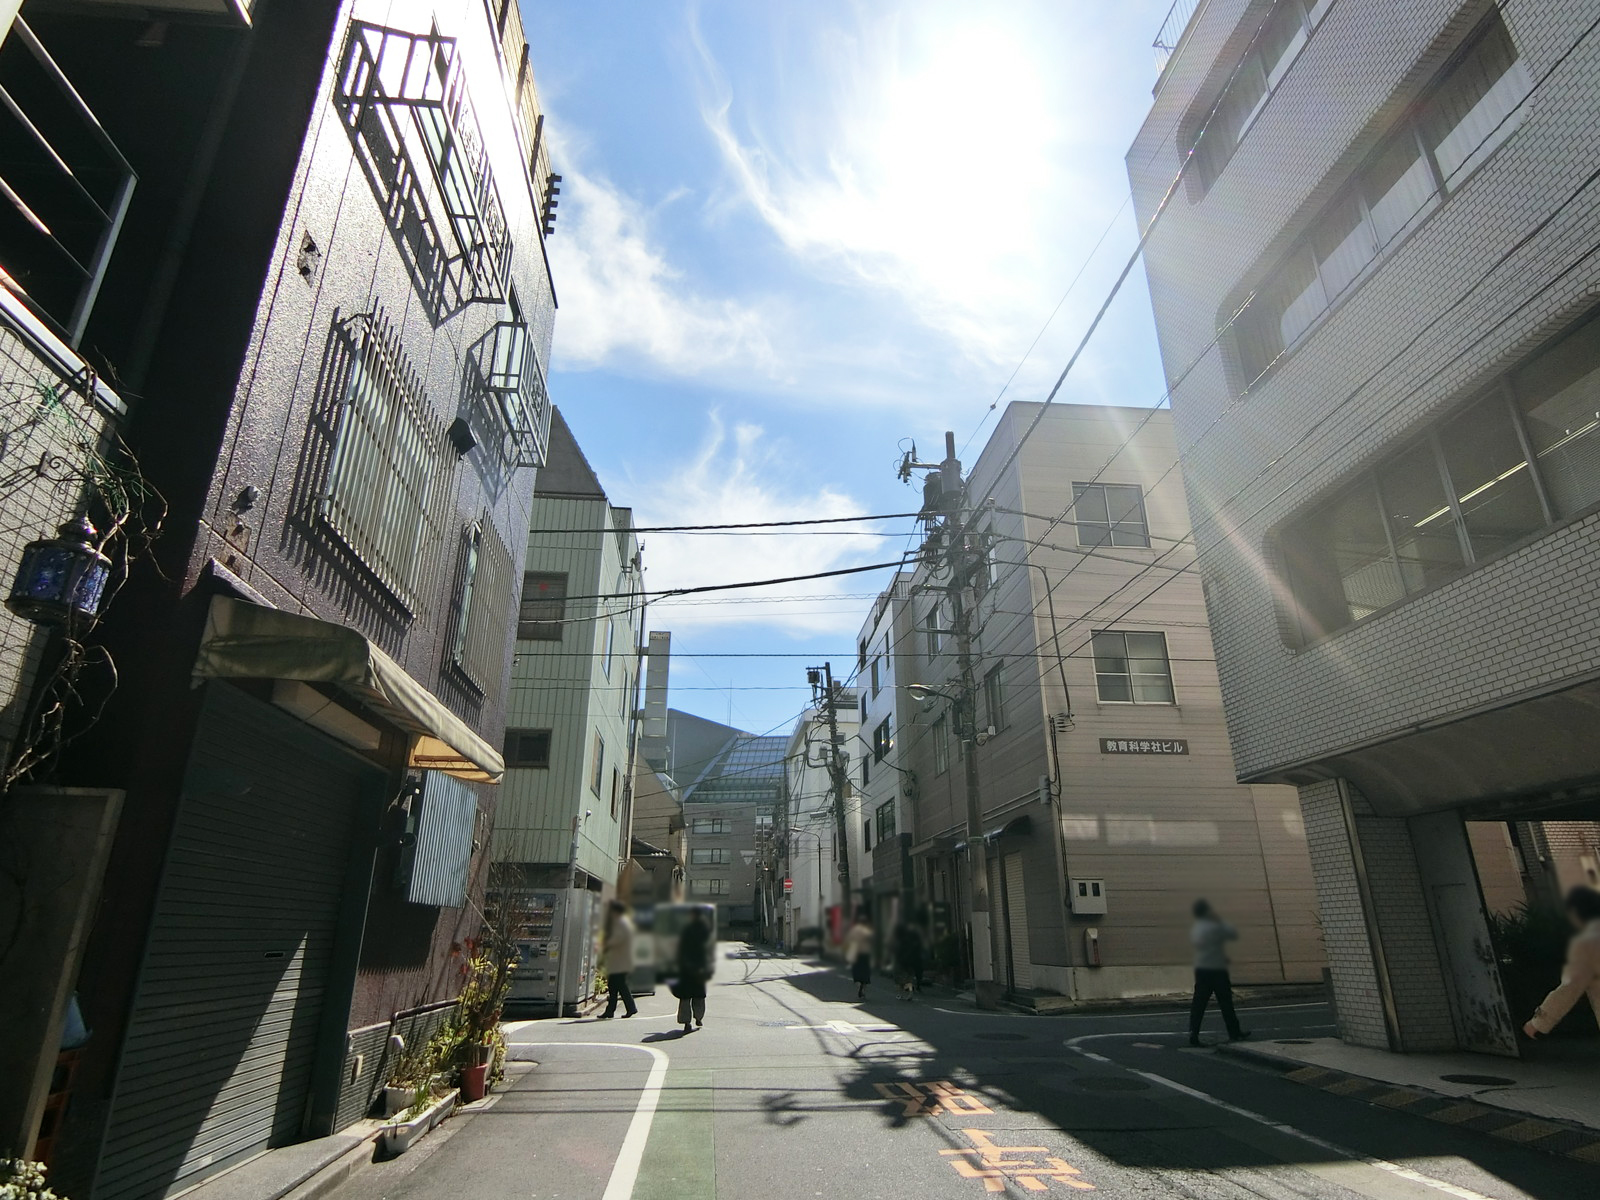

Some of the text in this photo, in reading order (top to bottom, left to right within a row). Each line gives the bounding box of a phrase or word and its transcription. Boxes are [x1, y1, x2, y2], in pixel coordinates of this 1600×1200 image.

[1106, 740, 1183, 753] 教育科学社ビル
